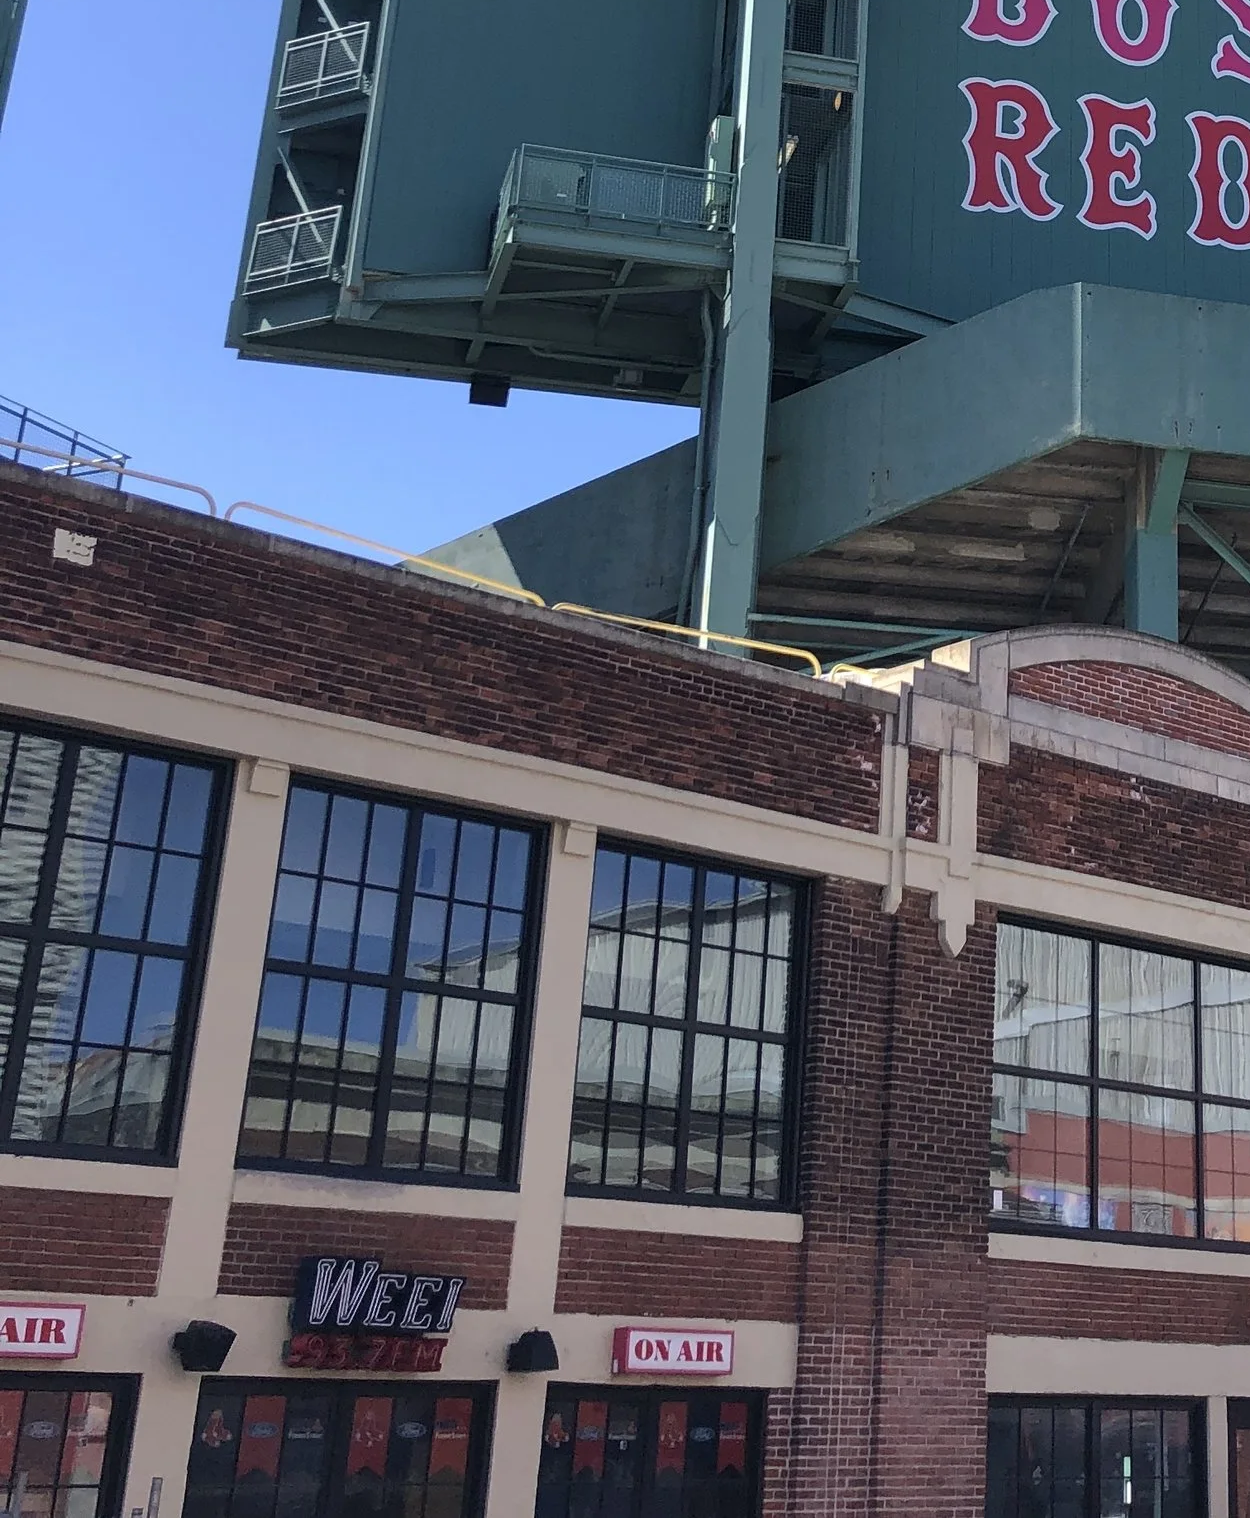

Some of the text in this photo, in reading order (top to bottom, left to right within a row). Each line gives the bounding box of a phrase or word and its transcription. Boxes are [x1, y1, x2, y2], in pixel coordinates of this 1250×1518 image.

[0, 1317, 66, 1344] AIR
[634, 1338, 724, 1362] ON AIR
